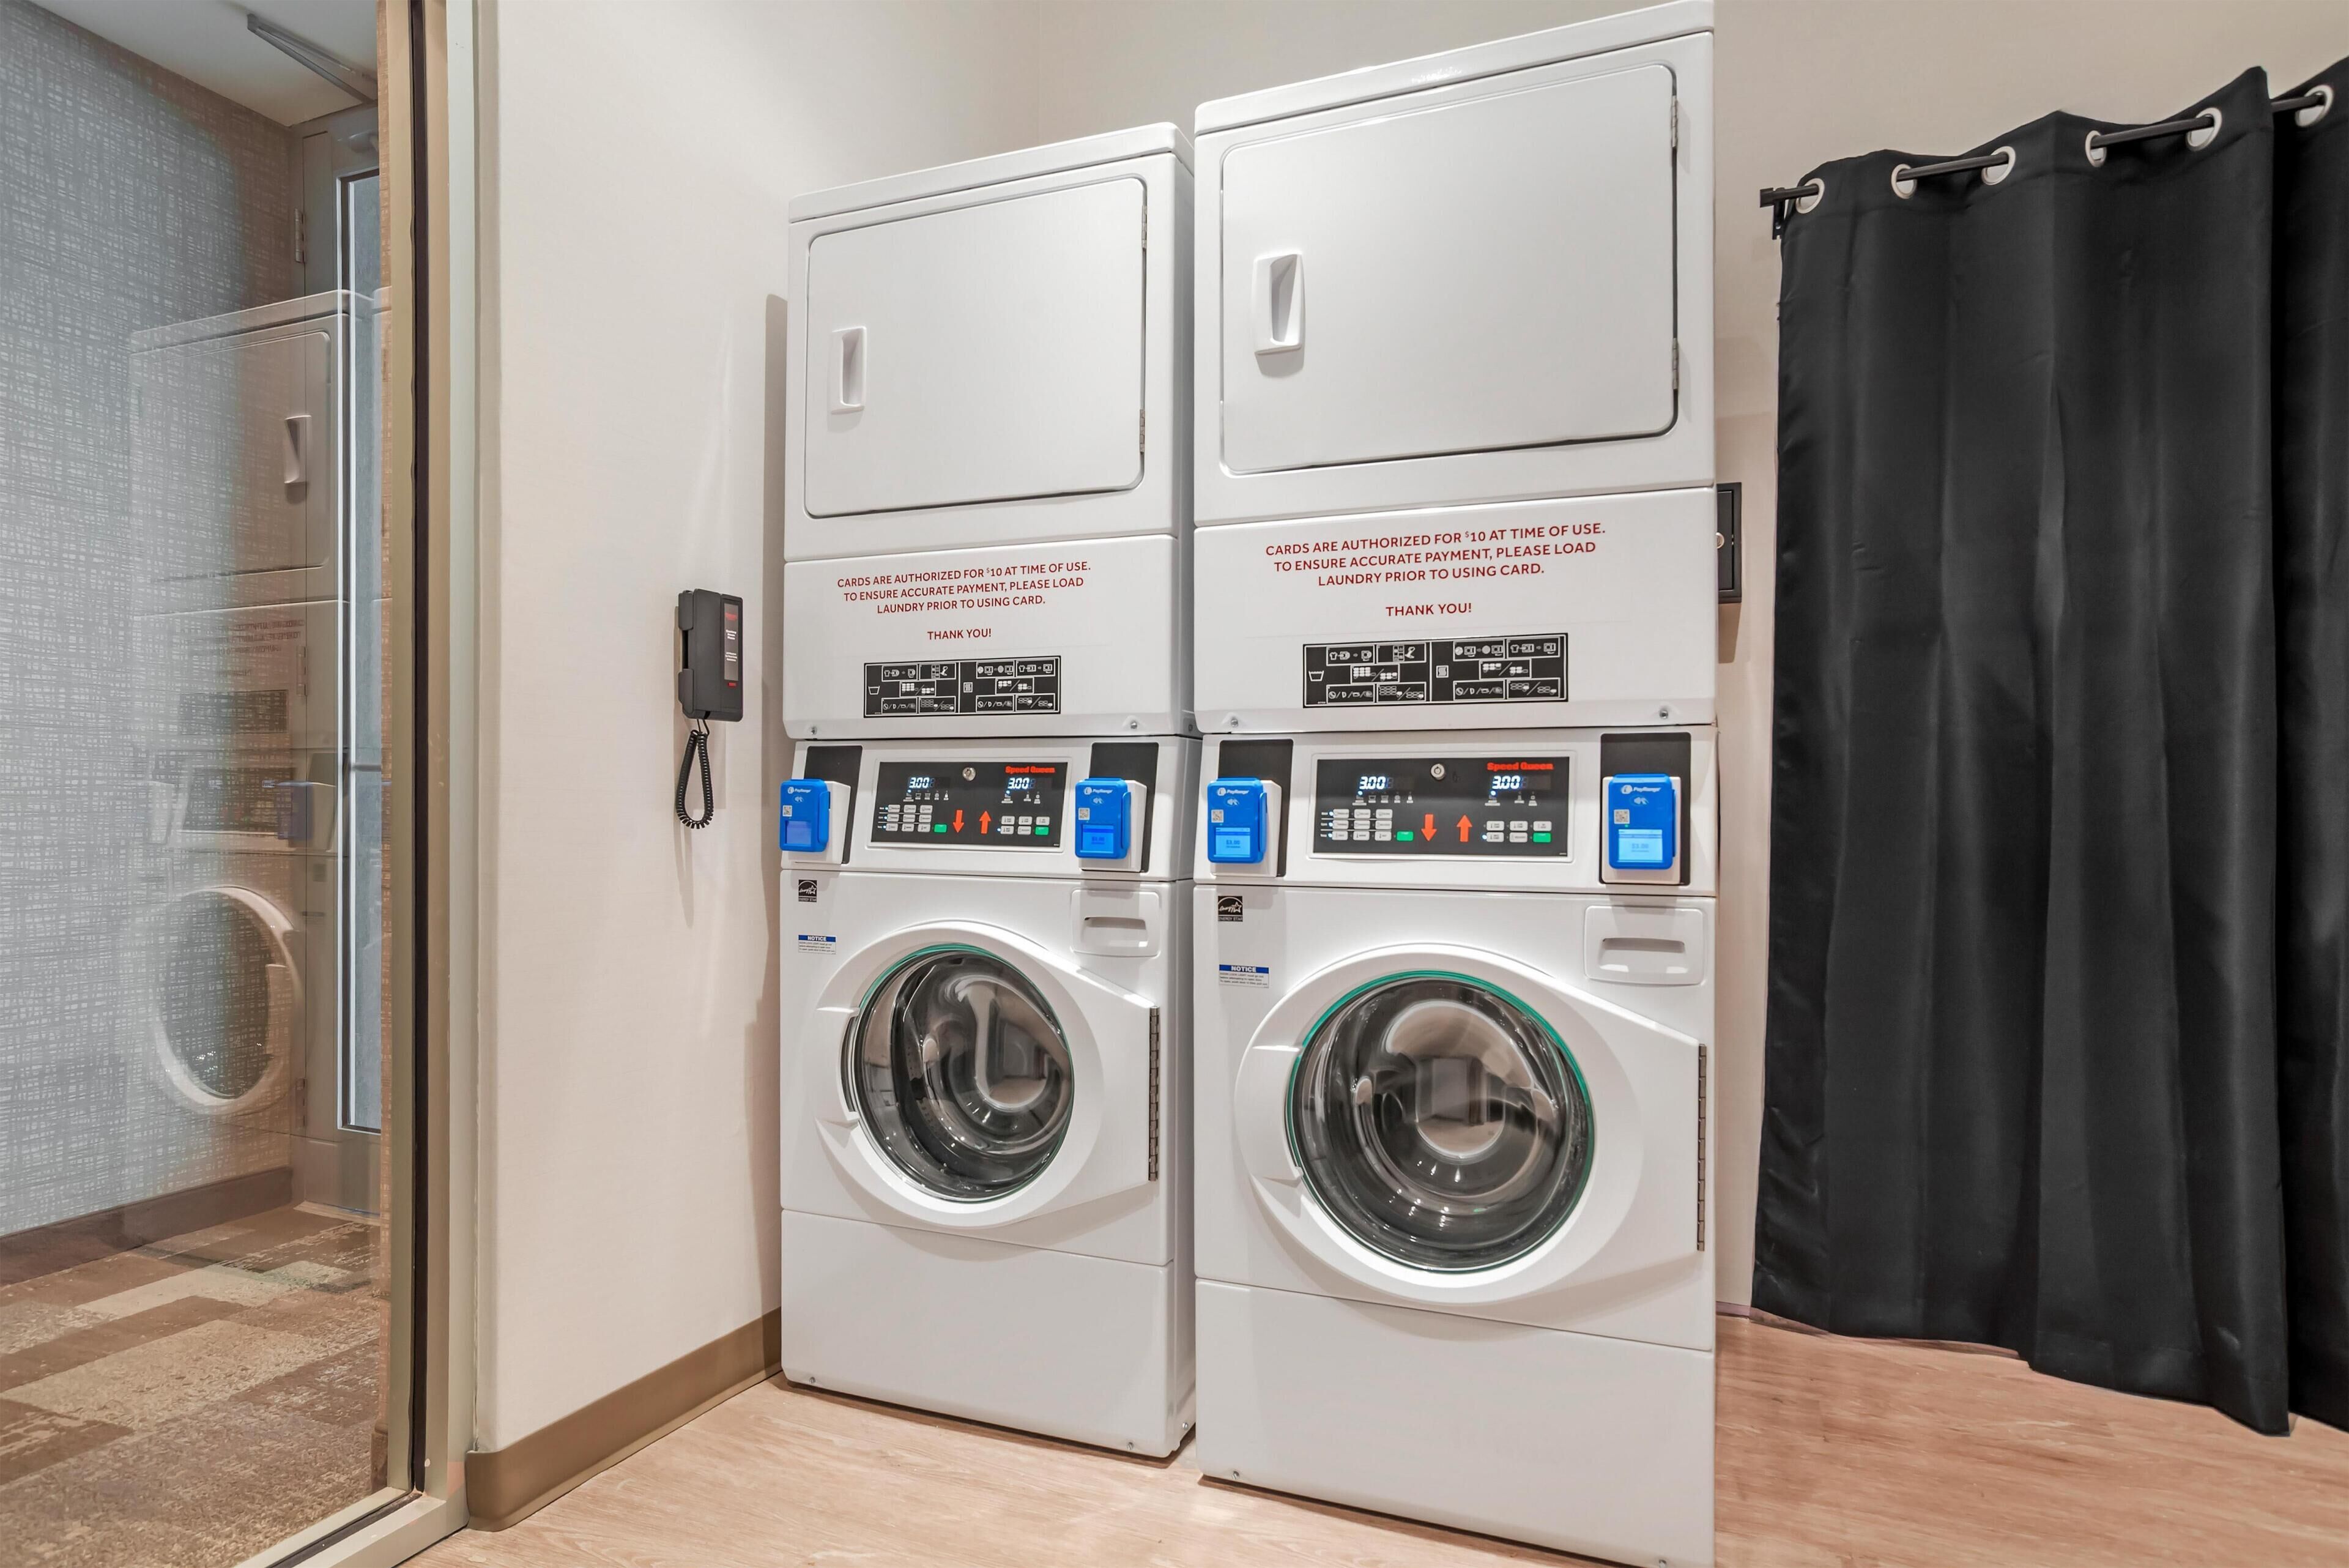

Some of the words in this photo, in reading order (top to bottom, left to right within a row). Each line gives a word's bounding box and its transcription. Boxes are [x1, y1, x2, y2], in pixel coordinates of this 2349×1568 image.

[1266, 543, 1310, 556] CARDS
[1313, 540, 1338, 552] ARE
[1341, 534, 1431, 551] AUTHORIZED
[1434, 532, 1461, 544] FOR
[1465, 531, 1486, 543] $10
[1489, 529, 1507, 541] AT
[1510, 526, 1545, 539] TIME
[1549, 525, 1568, 537] OF
[1572, 522, 1606, 536] USE.
[1274, 560, 1291, 571] TO
[1295, 557, 1346, 571] ENSURE
[1349, 551, 1422, 567] ACCURATE
[1425, 548, 1493, 562] PAYMENT,
[1496, 543, 1551, 559] PLEASE
[1554, 541, 1596, 555] LOAD
[837, 578, 870, 588] CARDS
[873, 575, 892, 586] ARE
[894, 570, 961, 583] AUTHORIZED
[963, 568, 984, 578] FOR
[986, 568, 1002, 578] $10
[1004, 566, 1017, 576] AT
[1020, 564, 1045, 574] TIME
[1048, 563, 1063, 573] OF
[1066, 561, 1091, 571] USE.
[1318, 572, 1382, 587] LAUNDRY
[1385, 568, 1426, 582] PRIOR
[1429, 568, 1449, 580] TO
[1452, 565, 1496, 579] USING
[1500, 562, 1545, 576] CARD.
[844, 592, 857, 602] TO
[859, 589, 898, 601] ENSURE
[900, 584, 954, 597] ACCURATE
[956, 581, 1007, 593] PAYMENT,
[1009, 579, 1050, 591] PLEASE
[1053, 577, 1084, 588] LOAD
[877, 602, 924, 614] LAUNDRY
[927, 600, 957, 611] PRIOR
[960, 598, 974, 608] TO
[977, 597, 1010, 608] USING
[1012, 595, 1045, 607] CARD.
[1386, 604, 1435, 617] THANK
[1438, 603, 1472, 614] YOU!
[927, 630, 963, 640] THANK
[967, 628, 992, 638] YOU!
[1487, 762, 1519, 771] Speed
[1520, 762, 1554, 770] Queen
[909, 777, 930, 789] 3.00
[1008, 777, 1030, 789] 3.00
[1359, 776, 1386, 790] 3.00
[1492, 775, 1521, 789] 3.00
